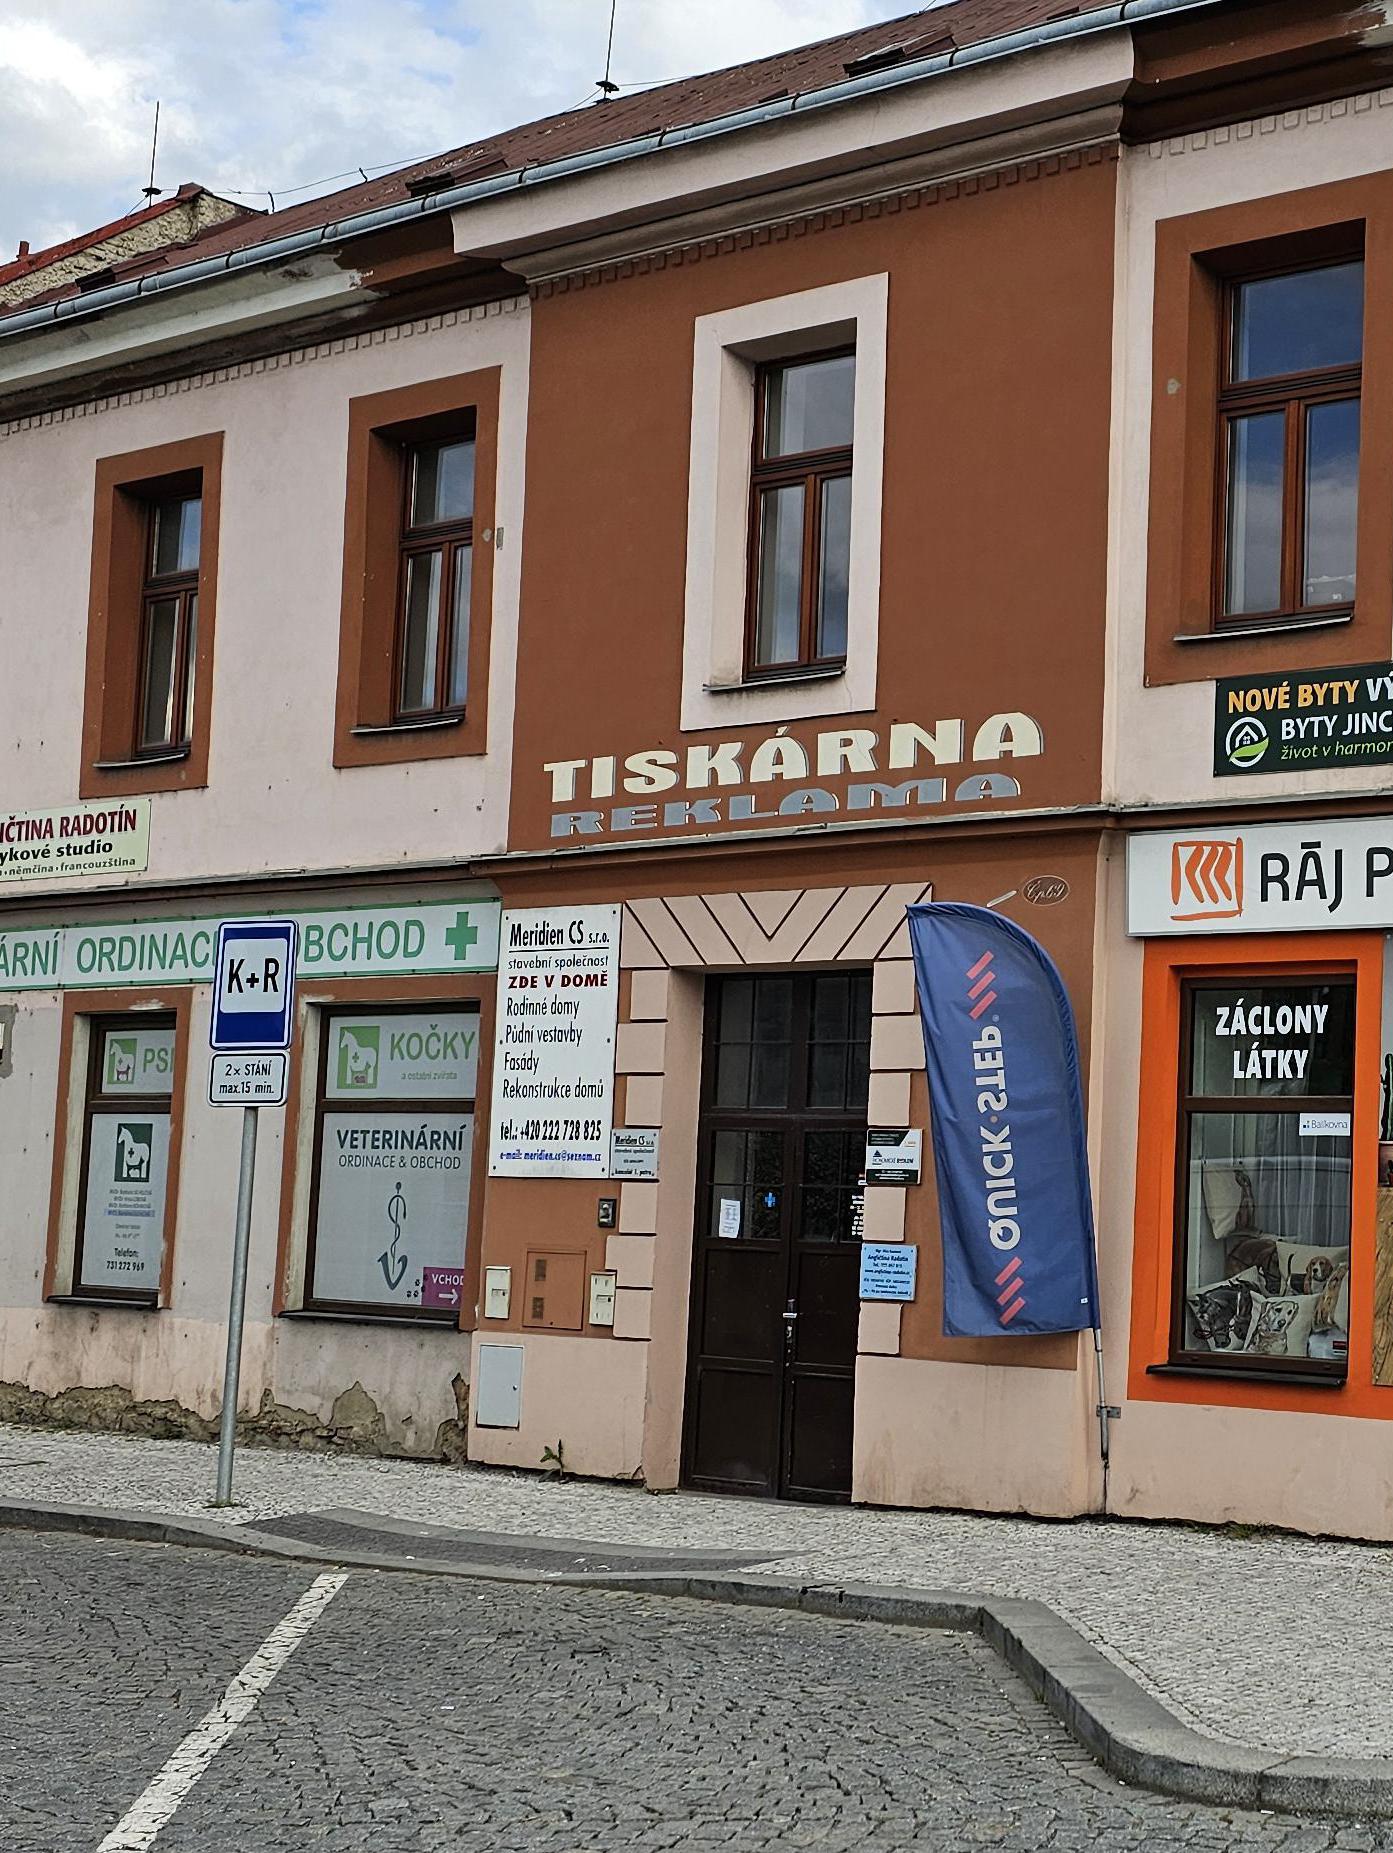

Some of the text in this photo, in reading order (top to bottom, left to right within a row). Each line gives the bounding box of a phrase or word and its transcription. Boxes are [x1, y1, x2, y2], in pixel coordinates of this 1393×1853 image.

[1228, 681, 1290, 714] NOVÉ
[1297, 679, 1360, 708] BYTY
[1281, 715, 1338, 741] BYTY
[543, 711, 1044, 802] TISKÁRNA
[1281, 745, 1318, 760] život
[1322, 747, 1329, 756] v
[550, 773, 1021, 838] REKLAMA
[60, 804, 137, 838] RADOTÍN
[56, 839, 113, 858] studio
[60, 857, 136, 871] francouzština
[509, 920, 610, 947] Meridien CS s.r.o.
[508, 954, 608, 970] stavební společnost
[227, 958, 279, 993] K+R
[508, 970, 608, 989] ZDE V DOMĚ
[507, 994, 580, 1019] Rodinné domy
[1216, 998, 1329, 1036] ZÁCLONY
[390, 1024, 475, 1061] KOČKY
[505, 1021, 583, 1047] Půdní vestavby
[244, 1060, 272, 1077] STÁNÍ
[504, 1050, 540, 1075] Fasády
[1233, 1041, 1309, 1079] LÁTKY
[255, 1082, 274, 1094] min.
[503, 1077, 571, 1098] Rekonstrukce
[337, 1124, 467, 1151] VETERINÁRNÍ
[500, 1119, 601, 1140] tel.: +420 222 728 825
[339, 1155, 460, 1169] ORDINACE & OBCHOD
[106, 1261, 117, 1270] 731
[119, 1261, 130, 1270] 272
